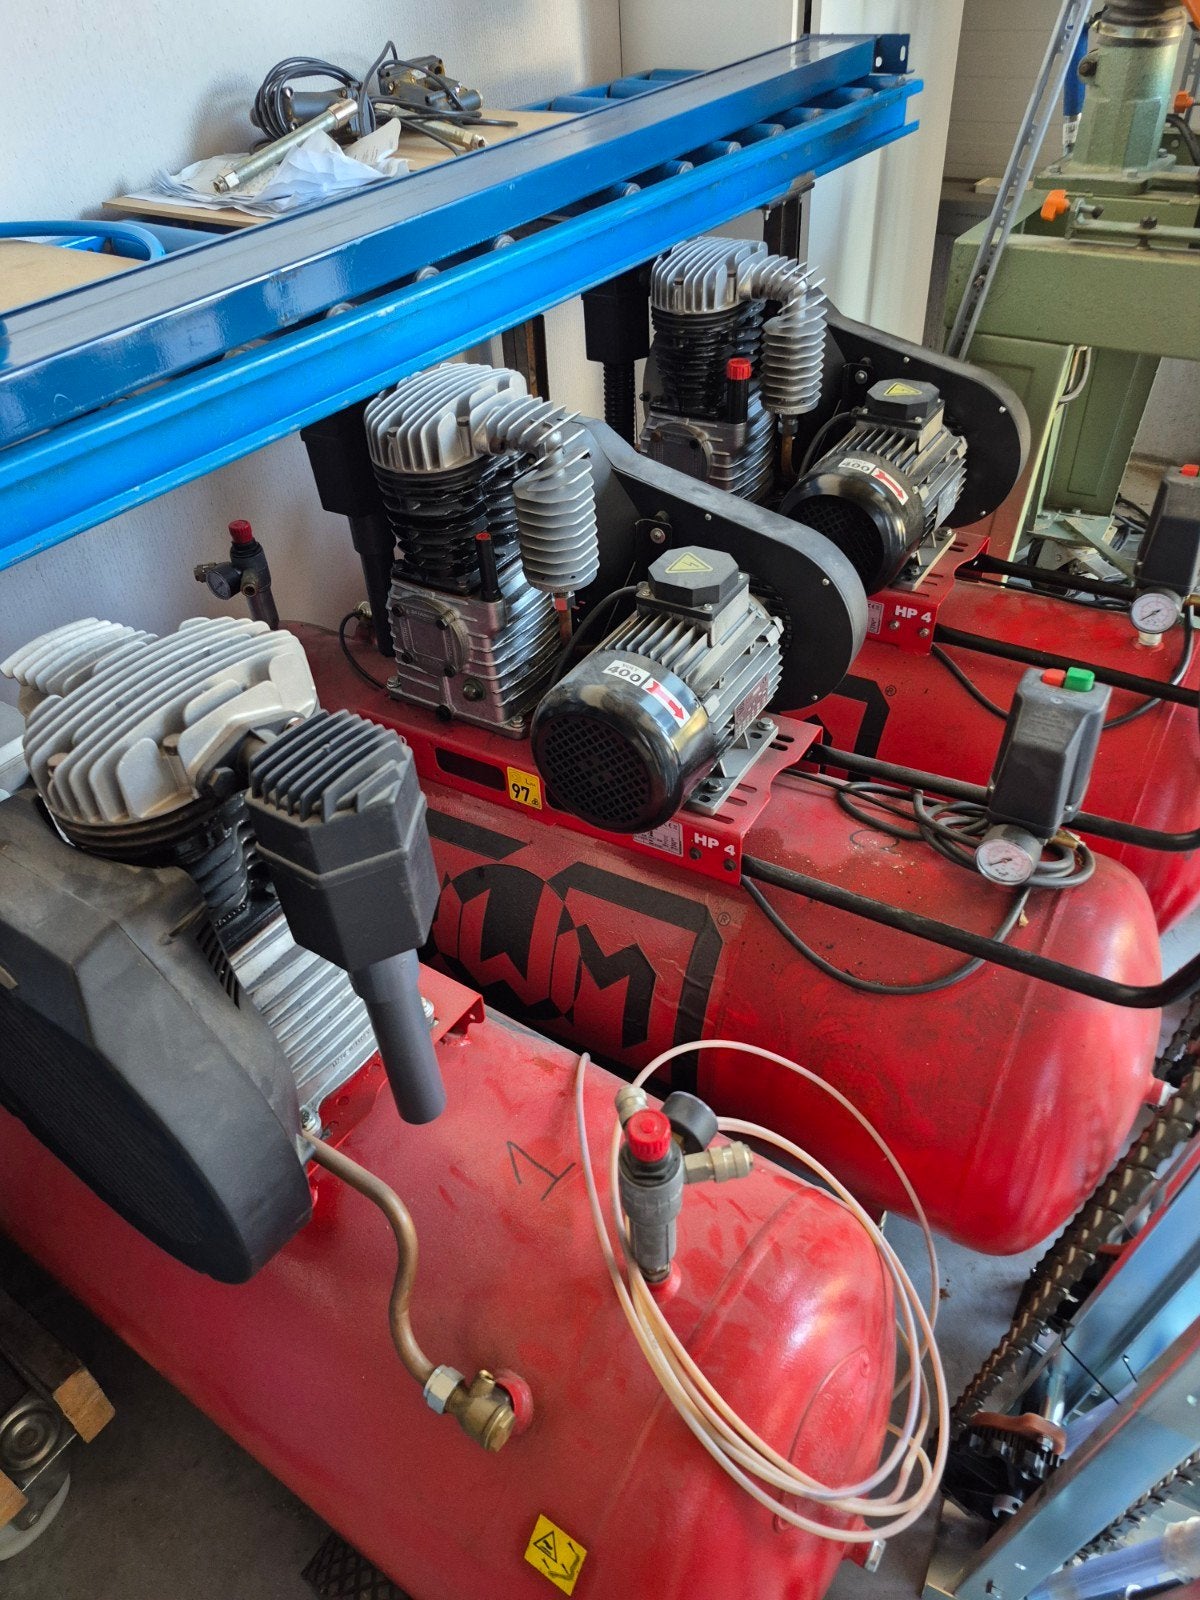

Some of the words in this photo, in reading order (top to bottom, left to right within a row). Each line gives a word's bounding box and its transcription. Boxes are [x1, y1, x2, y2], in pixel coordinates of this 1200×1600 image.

[894, 605, 918, 619] HP
[921, 612, 932, 623] 4
[607, 666, 642, 682] 400
[511, 783, 530, 802] 97
[694, 832, 719, 849] HP
[723, 844, 736, 857] 4
